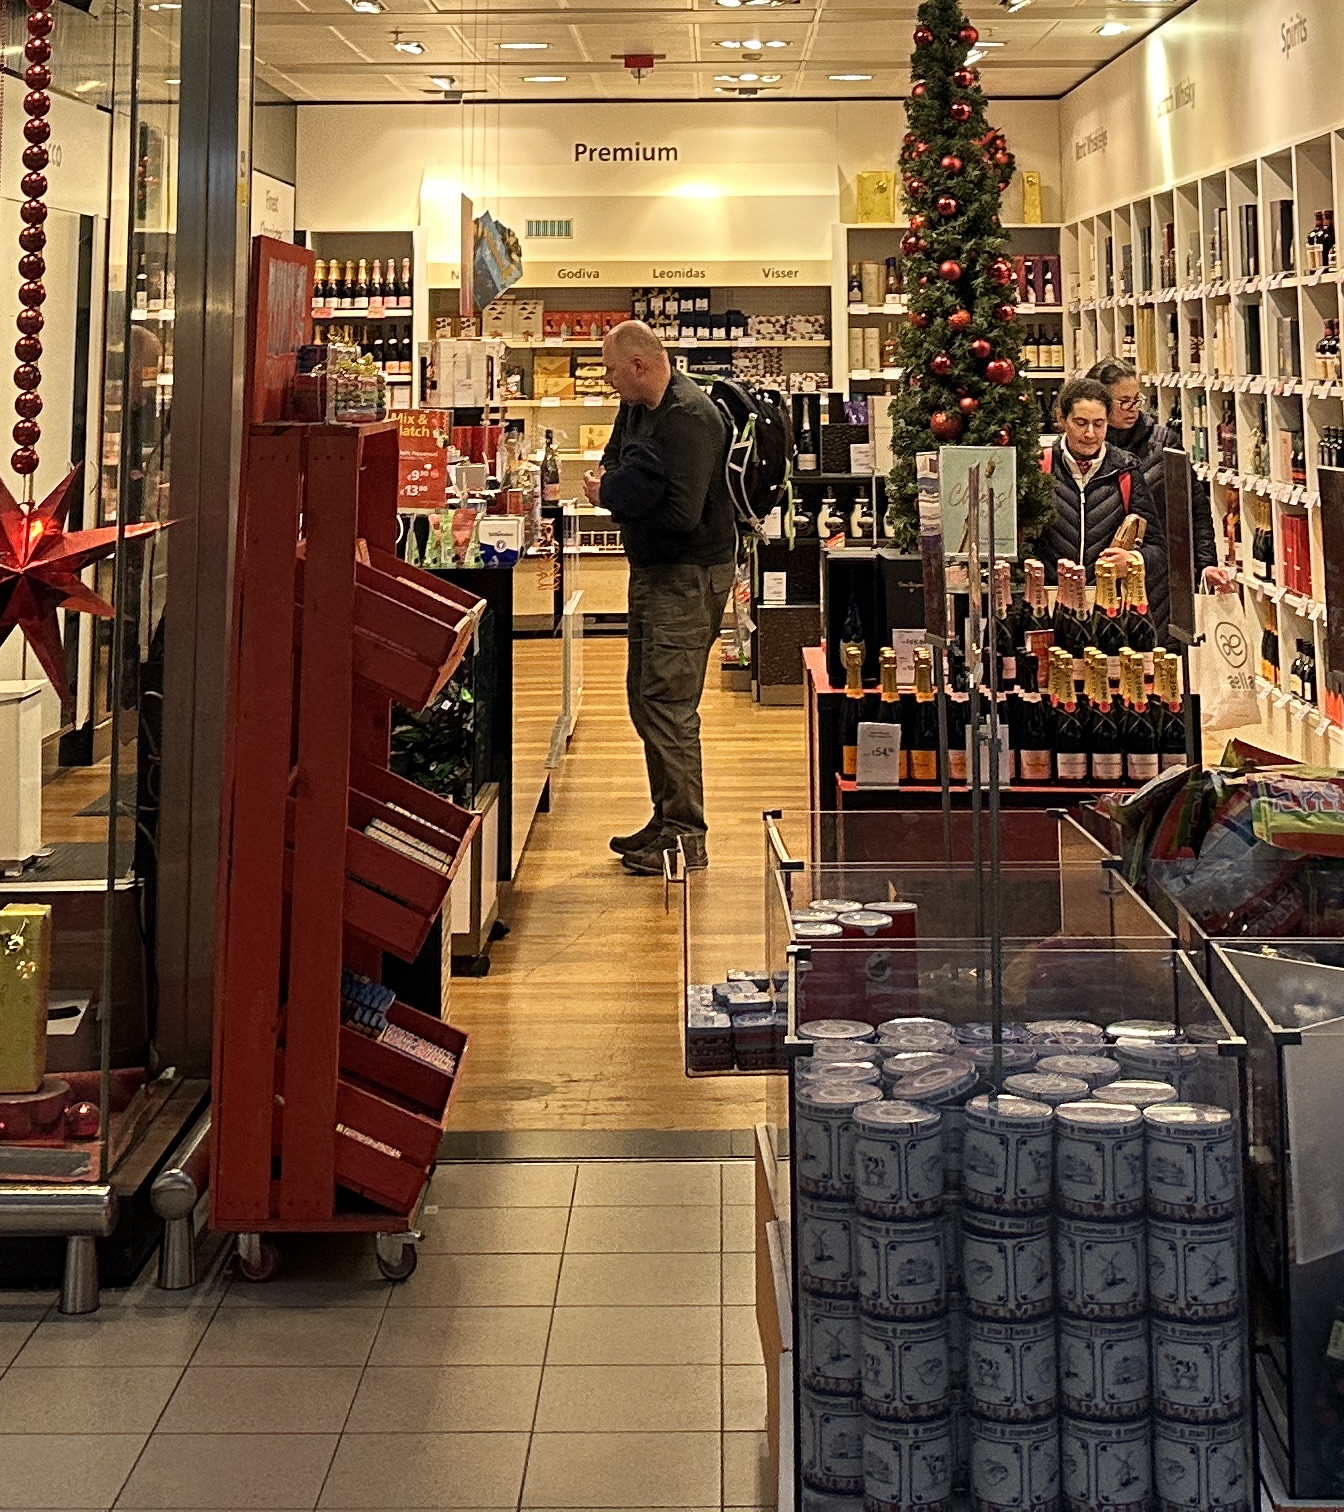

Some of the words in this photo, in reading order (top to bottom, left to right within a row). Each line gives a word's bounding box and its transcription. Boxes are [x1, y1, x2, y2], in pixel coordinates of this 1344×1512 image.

[1281, 12, 1308, 60] Spirits
[574, 142, 679, 163] Premium
[557, 267, 600, 280] Godiva
[652, 267, 706, 280] Leonidas
[762, 267, 800, 280] Visser
[391, 412, 417, 425] Mix
[418, 413, 429, 425] &
